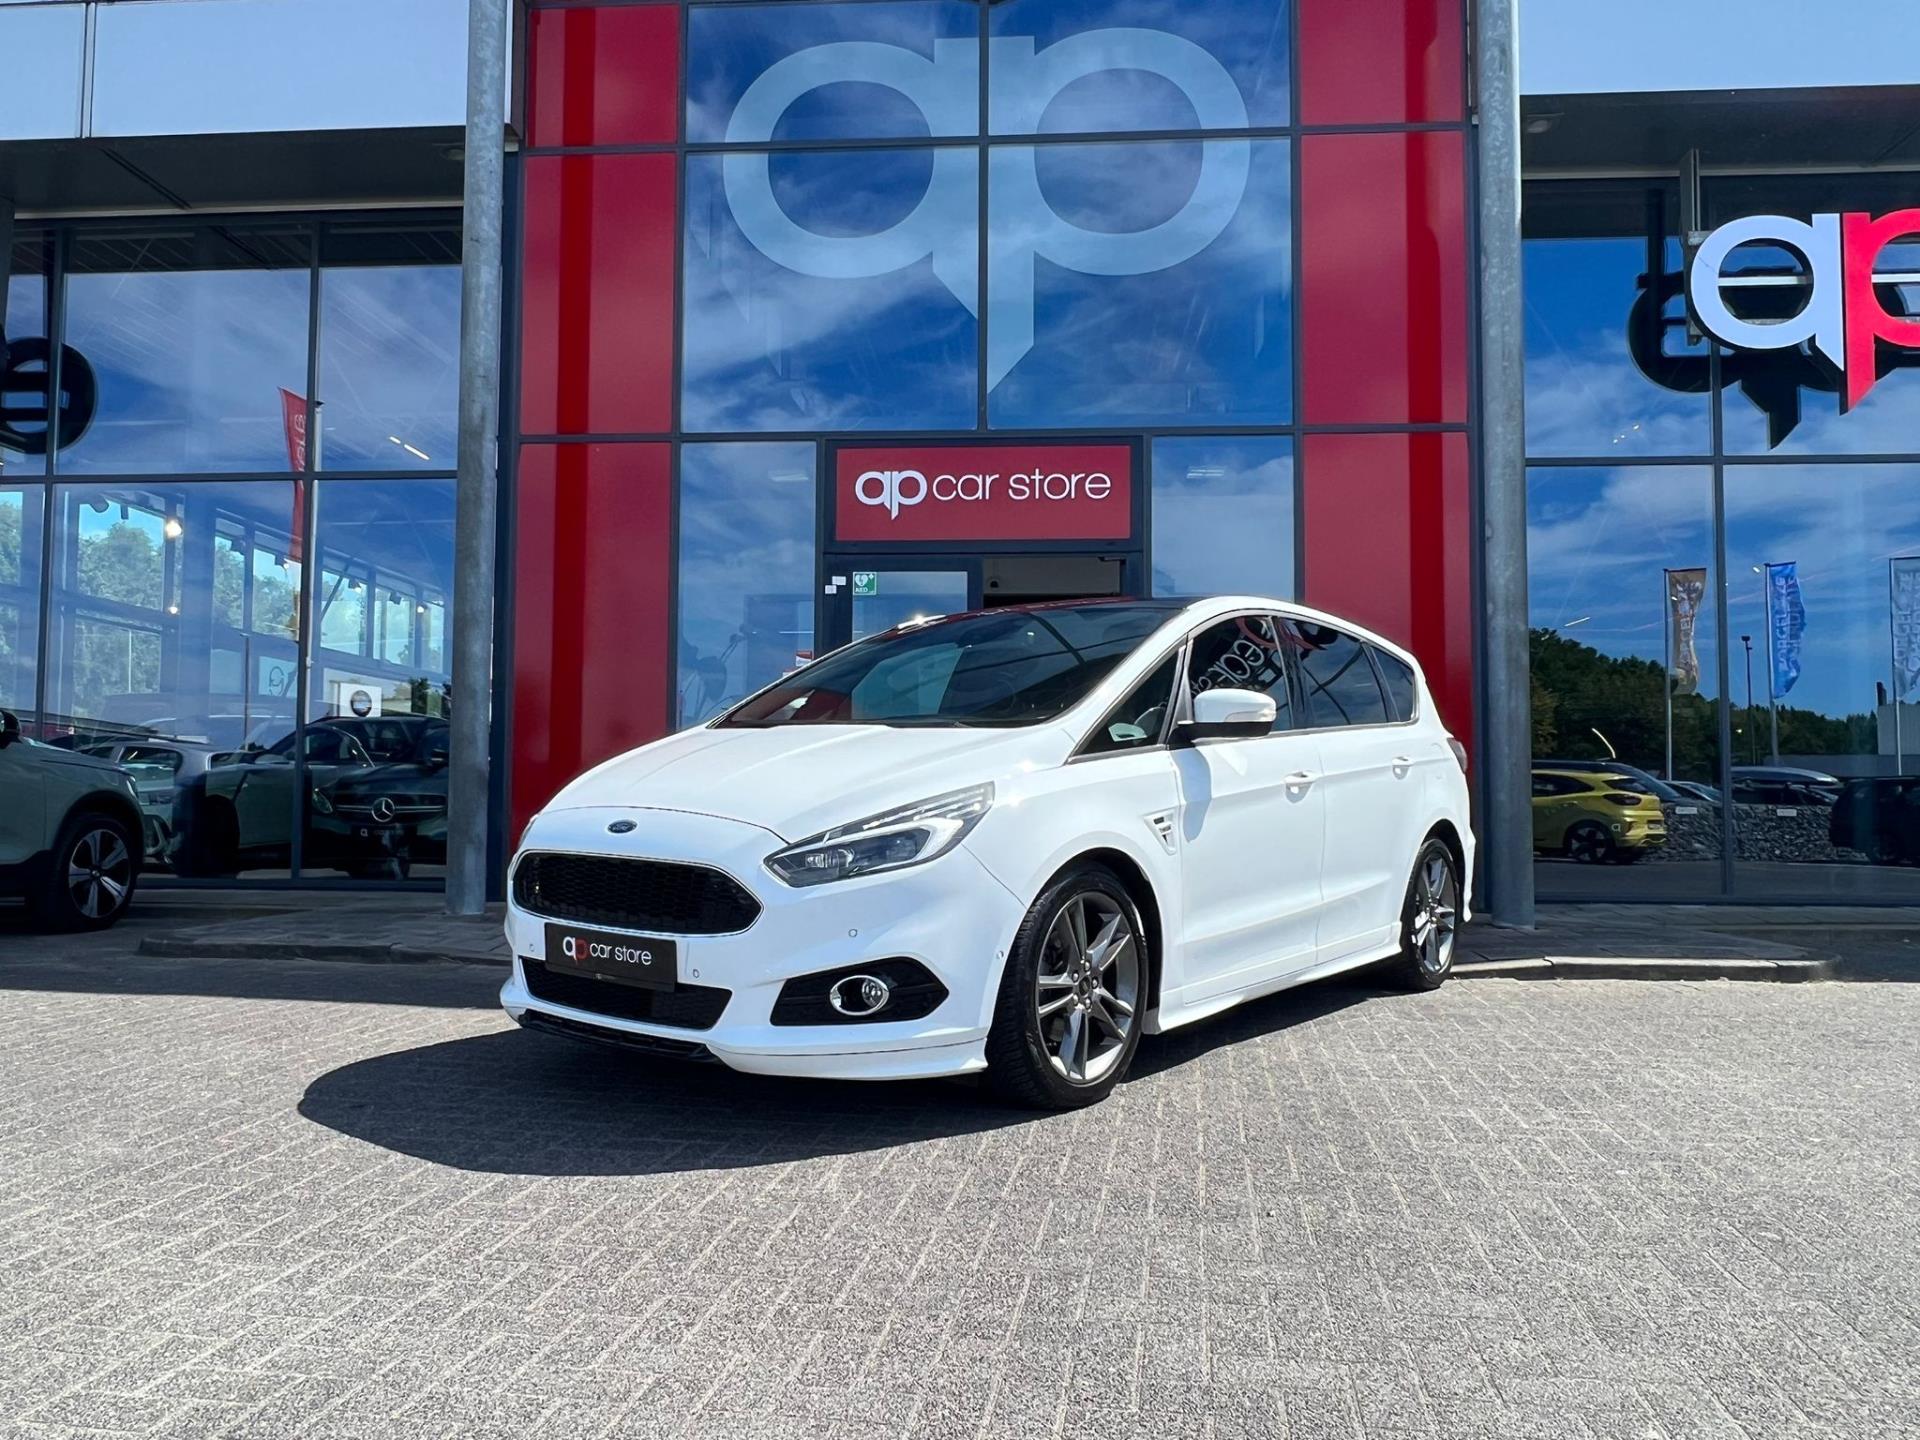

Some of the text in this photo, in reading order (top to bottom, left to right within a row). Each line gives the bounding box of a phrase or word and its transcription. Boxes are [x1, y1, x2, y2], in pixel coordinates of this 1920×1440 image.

[723, 28, 1249, 393] ap
[855, 468, 1111, 520] ap car store
[562, 936, 652, 965] ap car store
